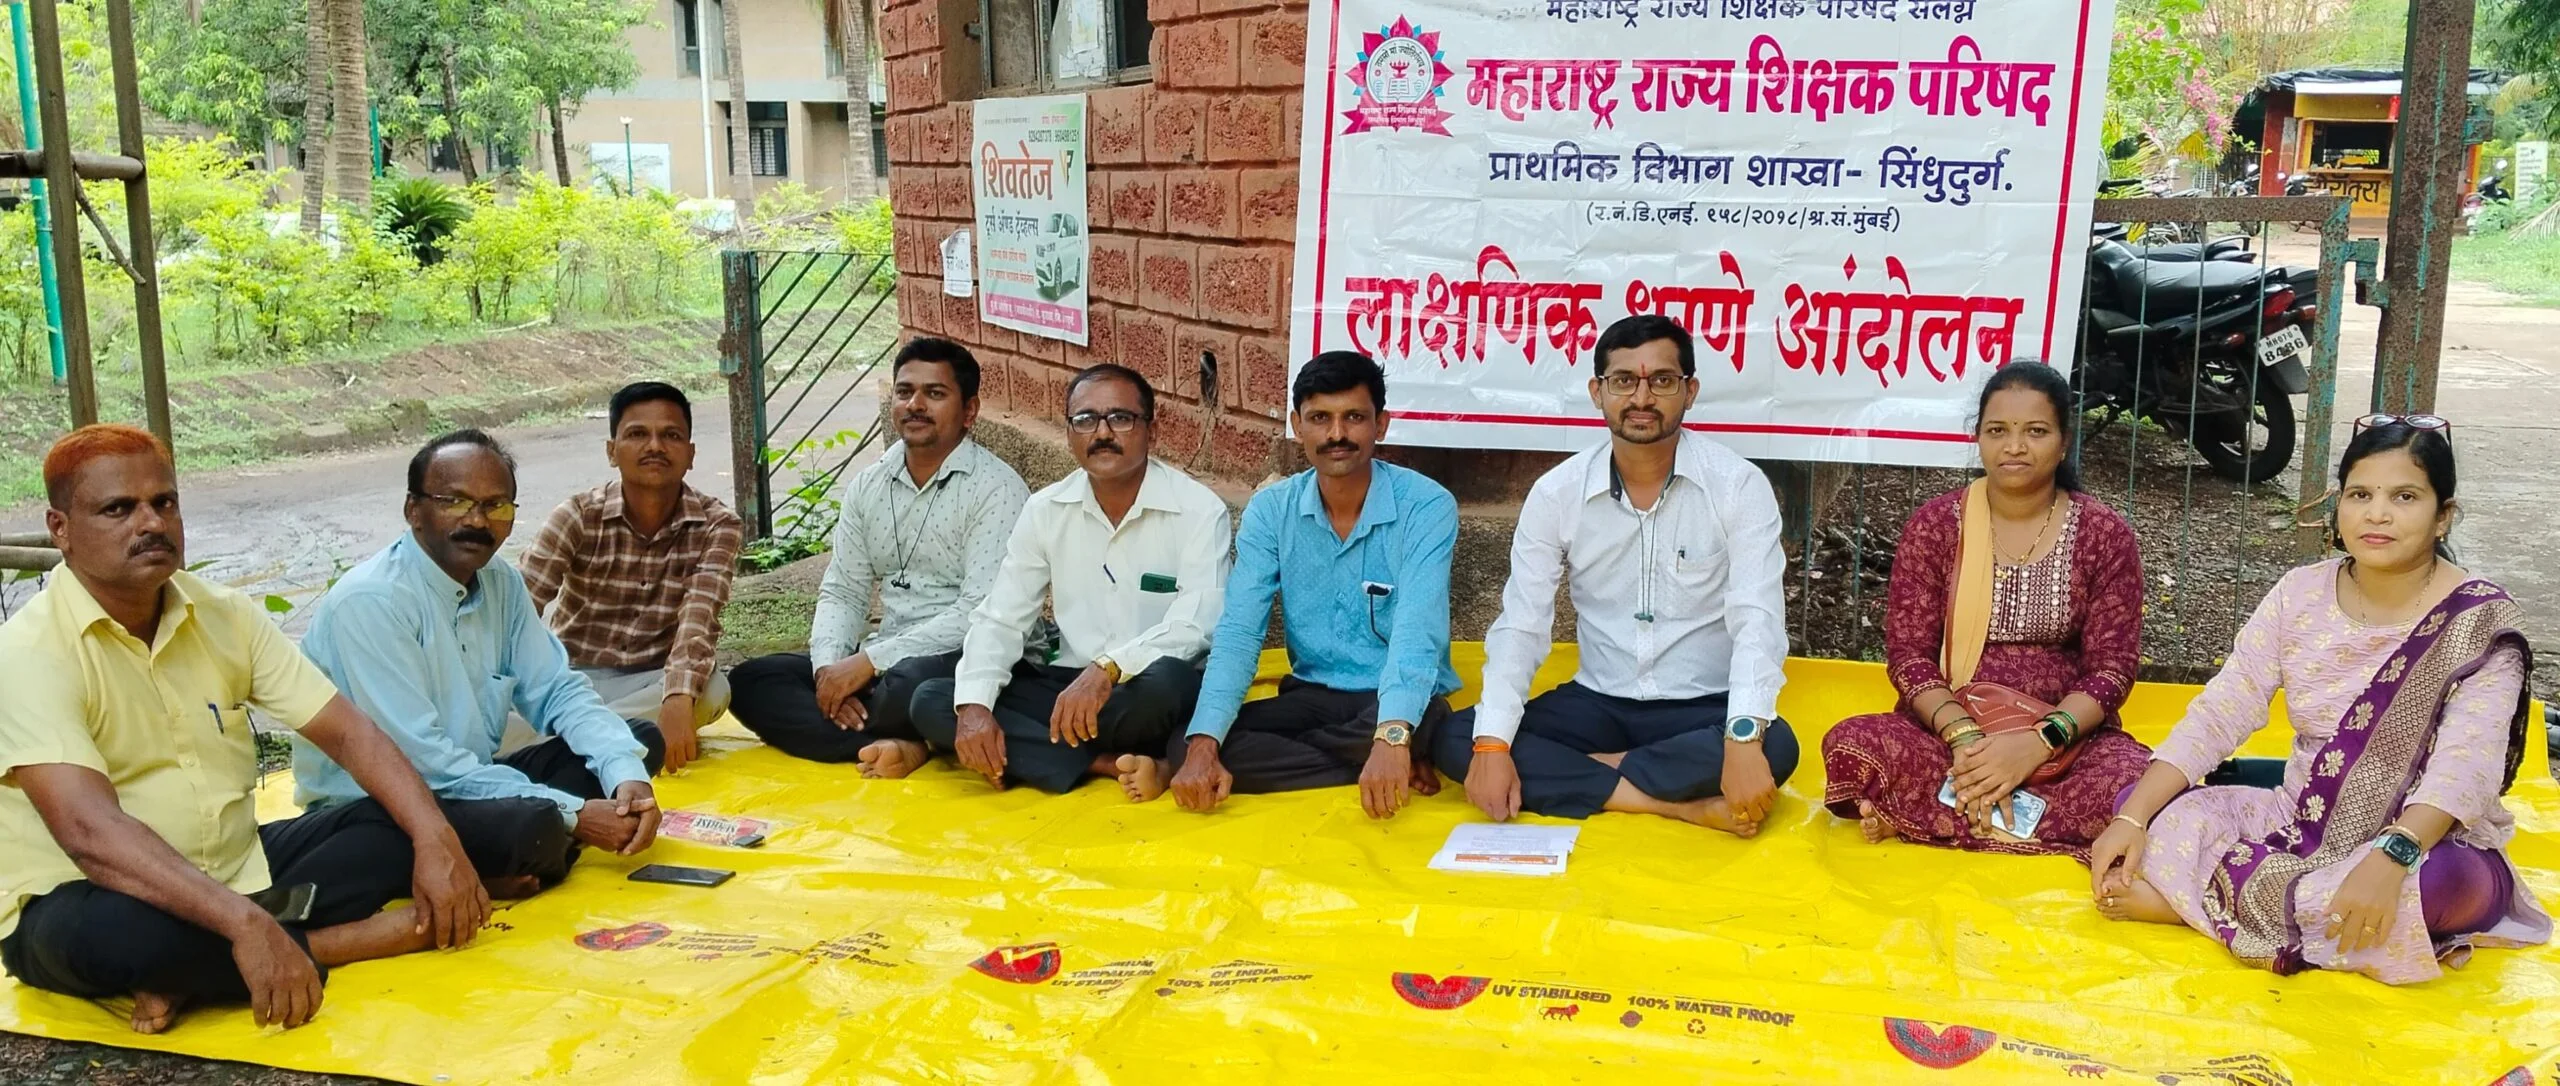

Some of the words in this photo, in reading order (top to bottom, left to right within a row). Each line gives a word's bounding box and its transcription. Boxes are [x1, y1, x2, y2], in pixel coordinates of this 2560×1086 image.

[1466, 58, 1622, 130] महाराष्ट्र
[1632, 59, 1736, 112] राज्य
[1745, 34, 1898, 122] शिक्षक
[1908, 35, 2056, 127] परिषद
[981, 140, 1053, 200] शिवतेज
[1488, 140, 1620, 182] प्राथमिक
[1632, 141, 1734, 185] विभाग
[1747, 155, 1862, 188] शाखा-
[1879, 145, 2013, 206] सिंधुदुर्ग.
[1345, 244, 1602, 370] लाक्षणिक
[1775, 253, 2024, 388] आंदोलन
[1492, 984, 1515, 997] UV
[1518, 986, 1612, 1003] STABILISED
[1627, 995, 1670, 1010] 100%
[1674, 1000, 1733, 1018] WATER
[1736, 1008, 1795, 1027] PROOF
